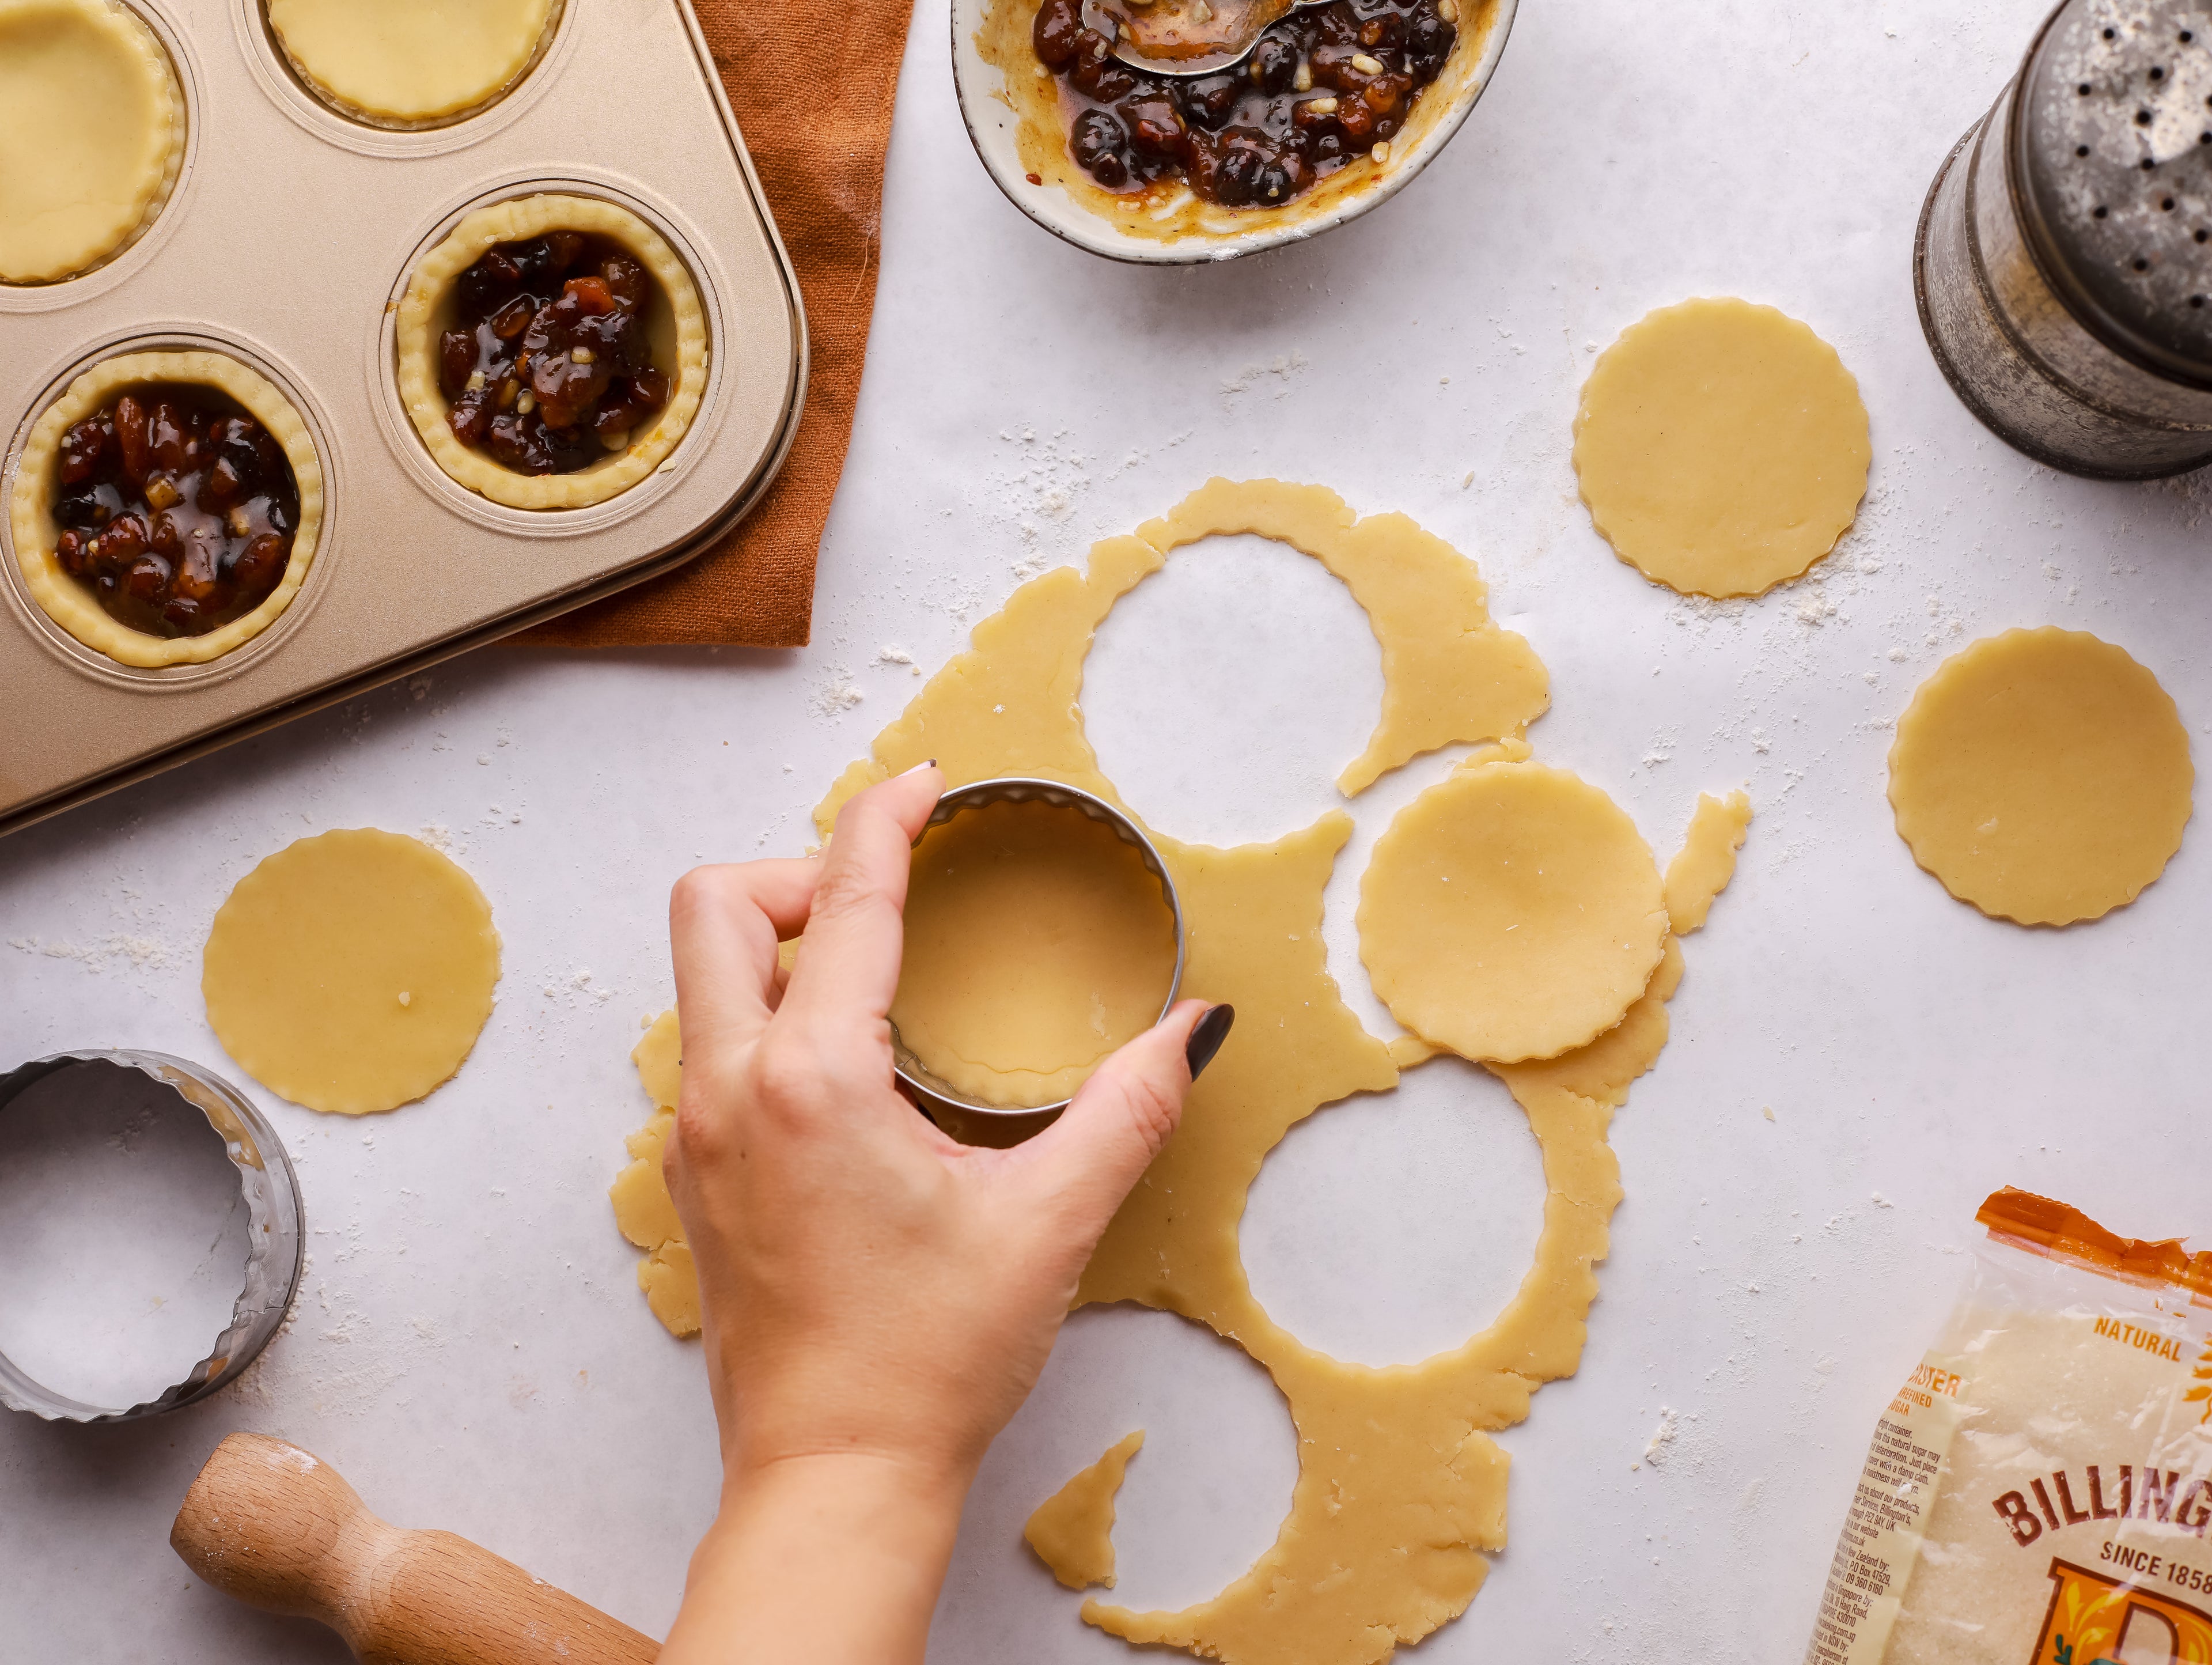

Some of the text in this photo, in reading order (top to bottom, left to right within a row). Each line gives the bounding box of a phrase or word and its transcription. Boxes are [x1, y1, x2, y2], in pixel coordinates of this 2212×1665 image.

[2093, 1315, 2182, 1363] NATURAL
[1888, 1423, 1912, 1439] container.
[1875, 1443, 1907, 1464] deterioration.
[1909, 1456, 1922, 1469] Just
[1922, 1461, 1937, 1474] place
[1891, 1437, 1911, 1451] natural
[1912, 1445, 1927, 1457] sugar
[1927, 1451, 1941, 1463] may
[1867, 1469, 1891, 1483] moistness
[1891, 1477, 1902, 1488] will
[1898, 1466, 1914, 1479] damp
[1915, 1470, 1929, 1485] cloth.
[1870, 1487, 1884, 1500] about
[1884, 1494, 1893, 1504] our
[1893, 1498, 1919, 1516] products,
[1991, 1465, 2212, 1548] BILLING
[1864, 1511, 1874, 1523] PE2
[1874, 1514, 1885, 1529] 9AY,
[1885, 1519, 1896, 1532] UK
[1880, 1504, 1911, 1526] Billington's,
[1859, 1523, 1879, 1539] website
[1856, 1550, 1880, 1567] Zealand
[1879, 1558, 1889, 1572] by:
[2100, 1541, 2212, 1594] SINCE 1858
[1846, 1573, 1855, 1584] 09
[1855, 1576, 1868, 1590] 360
[1868, 1581, 1883, 1595] 6160
[1849, 1561, 1859, 1573] P.O
[1859, 1564, 1871, 1578] Box
[1872, 1569, 1891, 1587] 47529,
[1838, 1584, 1863, 1602] Singapore
[1863, 1594, 1874, 1608] by:
[1836, 1611, 1857, 1628] 430010
[1839, 1599, 1851, 1614] Haig
[1851, 1604, 1868, 1621] Road,
[1816, 1645, 1842, 1663] macpherson
[1828, 1634, 1840, 1648] NSW
[1839, 1640, 1849, 1653] by:
